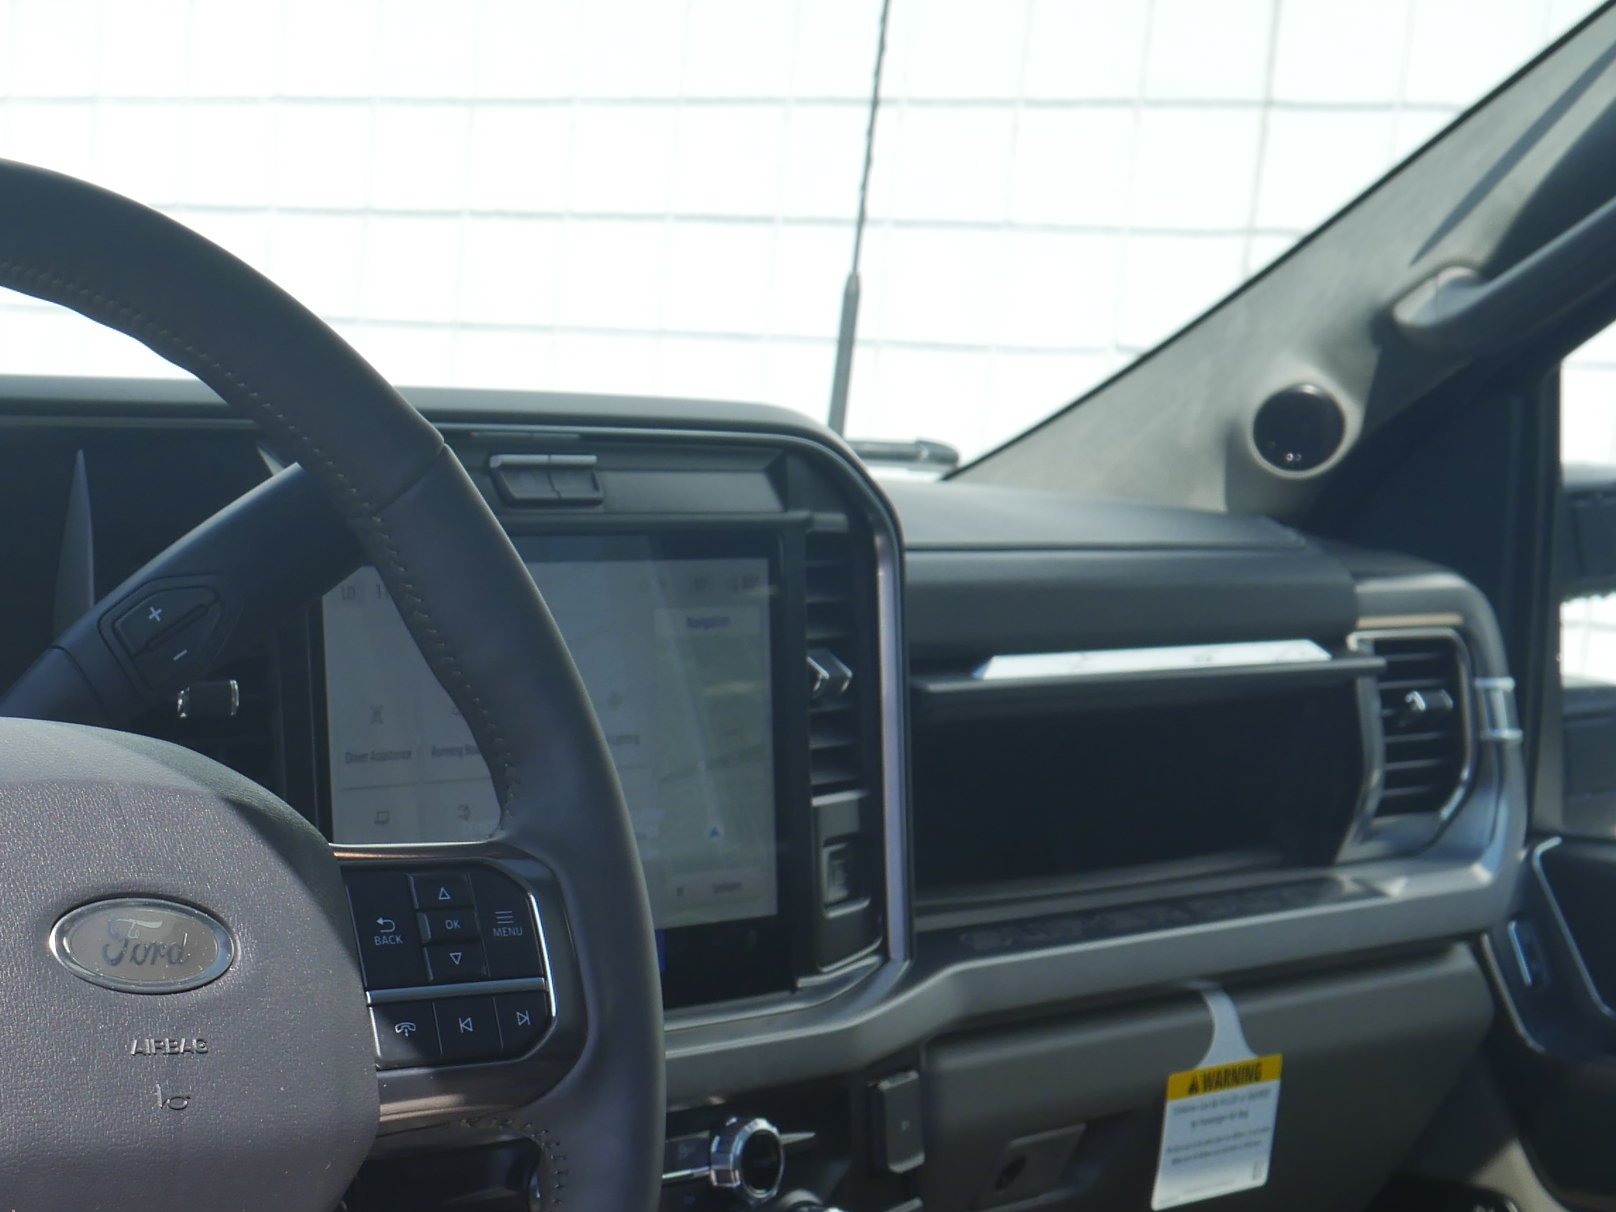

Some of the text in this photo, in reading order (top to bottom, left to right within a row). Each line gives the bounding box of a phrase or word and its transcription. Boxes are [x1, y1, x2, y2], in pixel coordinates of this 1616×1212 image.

[445, 919, 461, 930] OK
[492, 927, 523, 937] MENU
[101, 918, 189, 967] Ford
[373, 935, 404, 946] BACK
[130, 1037, 209, 1056] AIRBAG
[1203, 1062, 1264, 1091] WARNING
